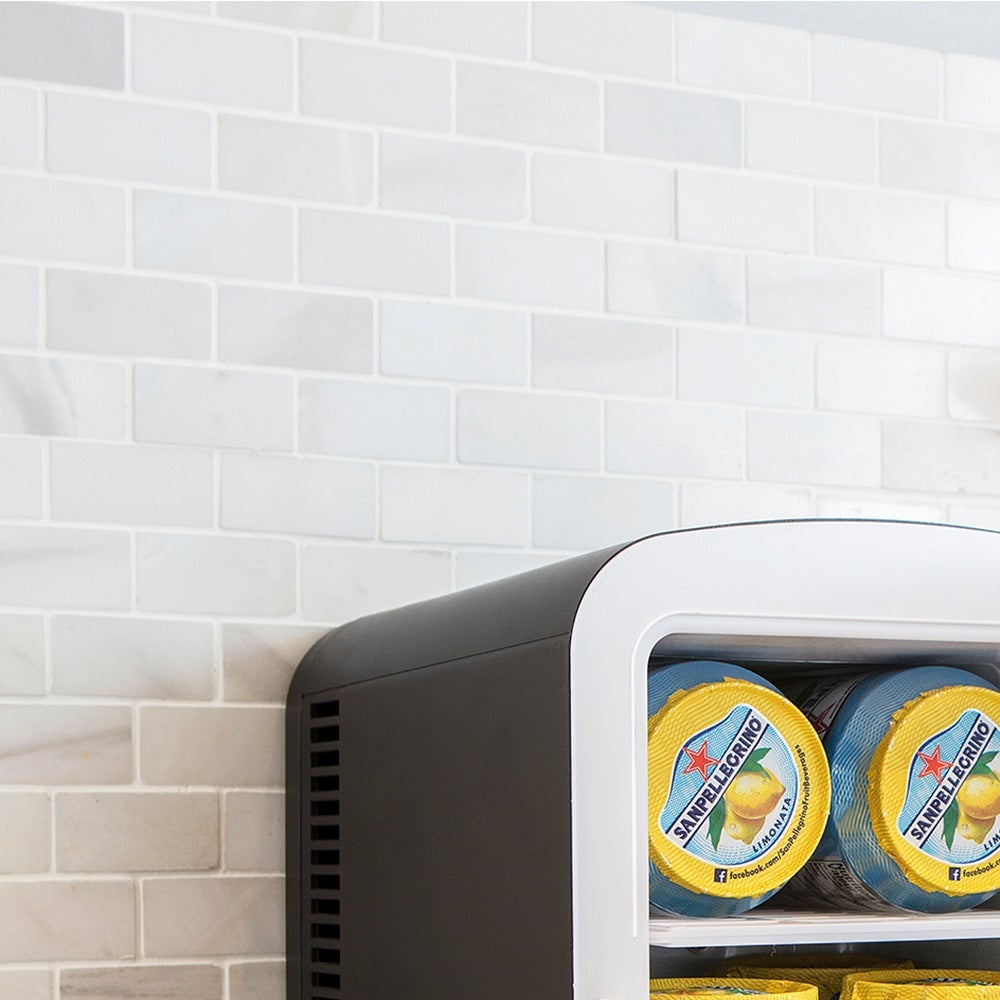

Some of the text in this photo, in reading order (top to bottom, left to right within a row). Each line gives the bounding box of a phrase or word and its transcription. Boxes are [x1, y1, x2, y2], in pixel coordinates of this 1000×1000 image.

[674, 717, 762, 841] SANPELLEGRINO
[752, 797, 792, 853] LIMONATA
[911, 722, 990, 841] SANPELLEGRINO
